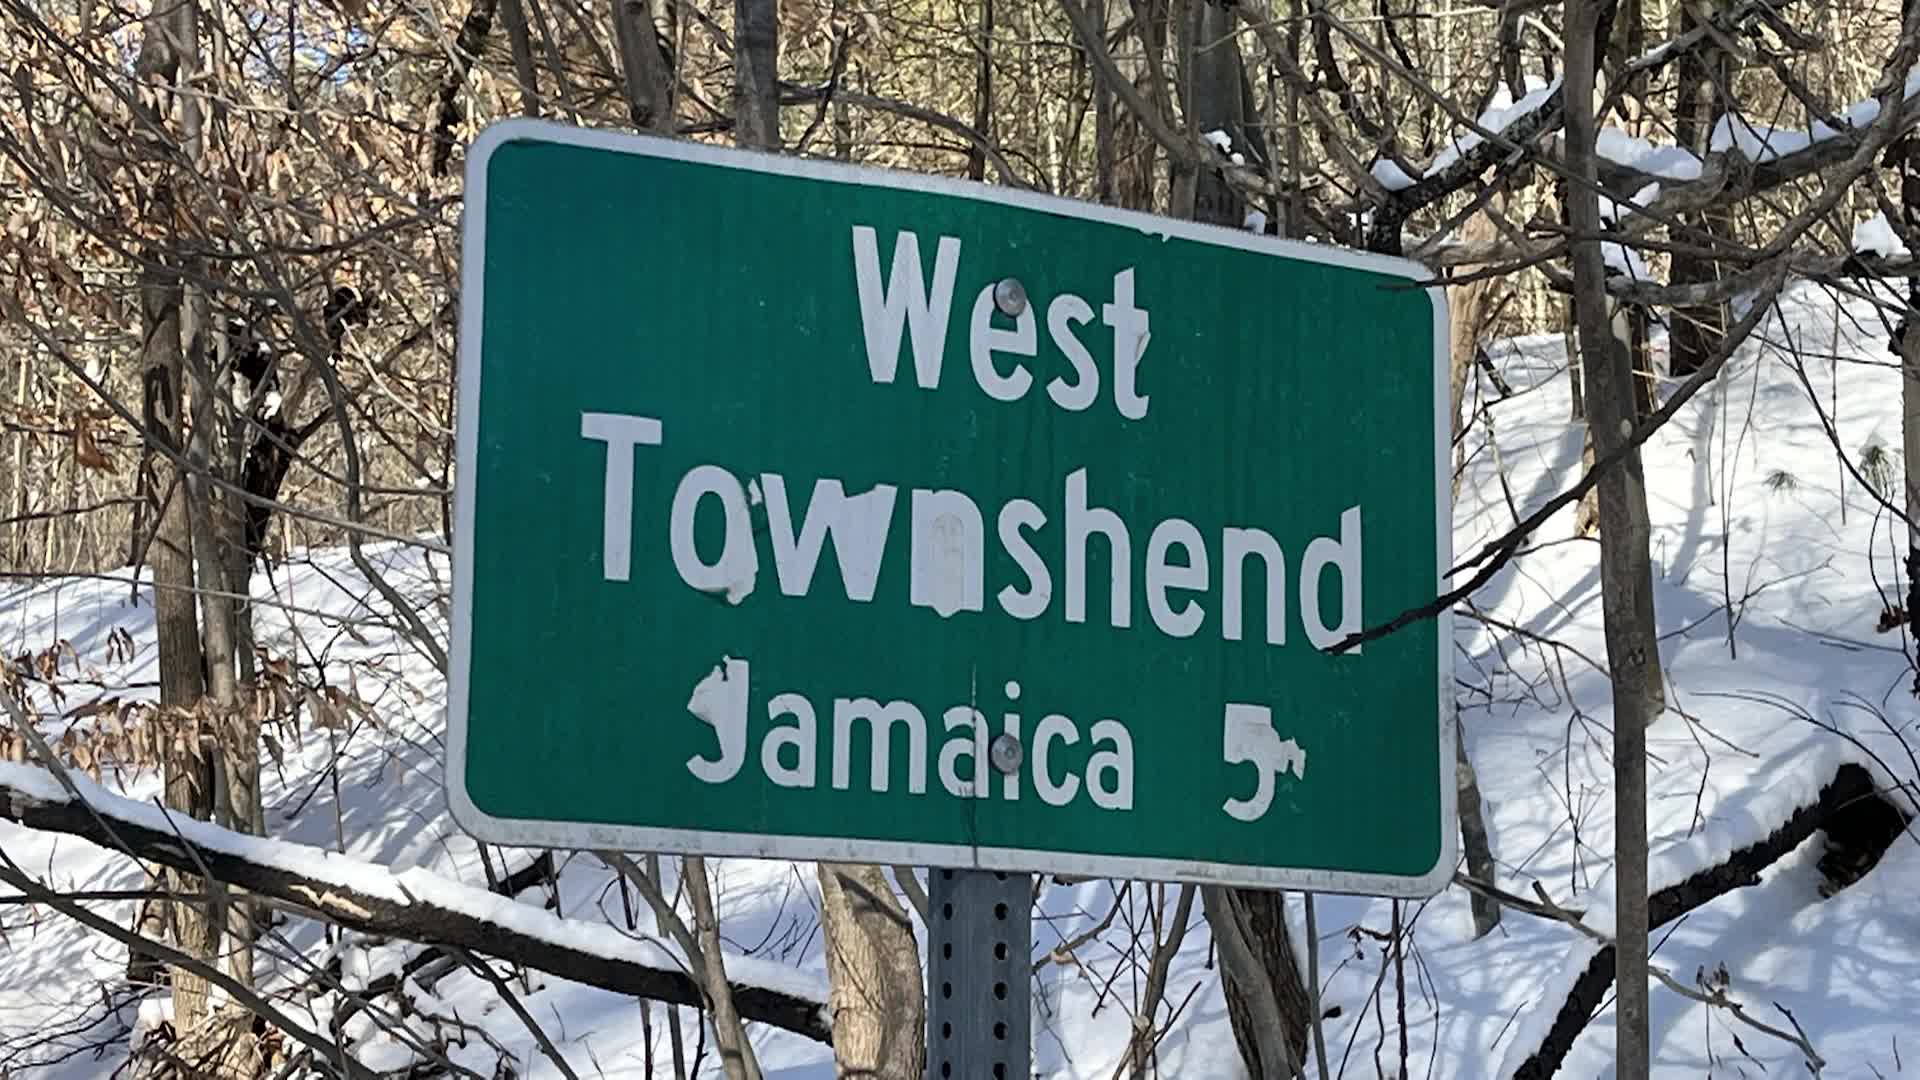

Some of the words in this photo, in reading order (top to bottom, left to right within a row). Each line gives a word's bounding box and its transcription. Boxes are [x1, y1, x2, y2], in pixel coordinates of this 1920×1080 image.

[852, 225, 1151, 420] West
[580, 412, 1363, 656] Townshend
[686, 656, 1135, 811] Jamaica
[1223, 703, 1306, 821] 5
